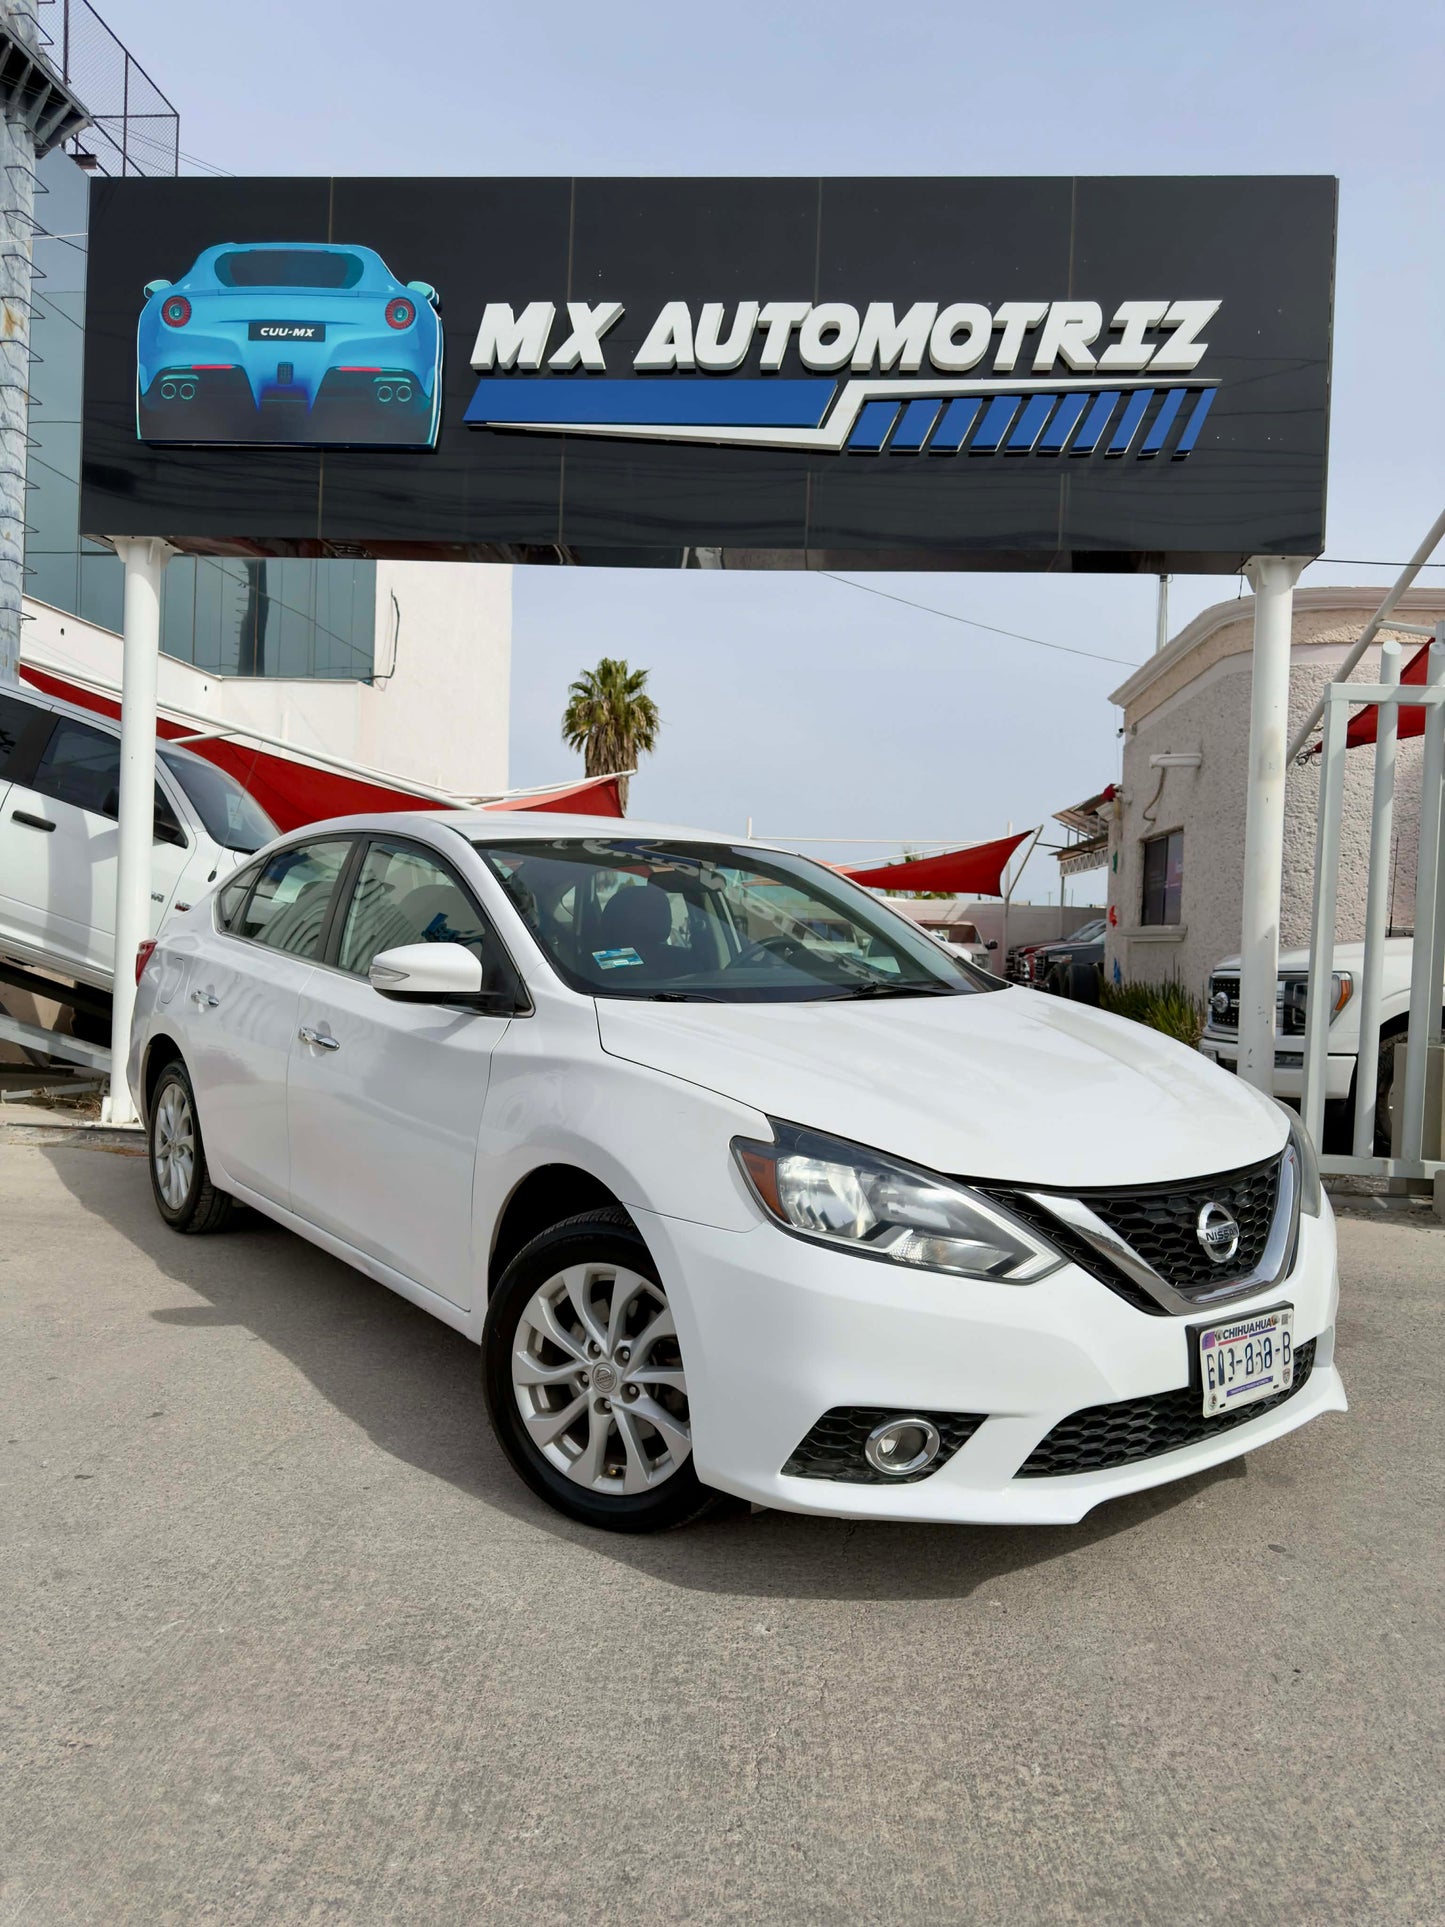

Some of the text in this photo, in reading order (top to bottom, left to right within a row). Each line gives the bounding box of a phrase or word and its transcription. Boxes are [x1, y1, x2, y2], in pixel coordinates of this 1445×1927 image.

[260, 327, 315, 337] CUU-MX
[469, 300, 1223, 372] MX AUTOMOTRIZ
[1222, 1317, 1271, 1340] CHIHUAHUA
